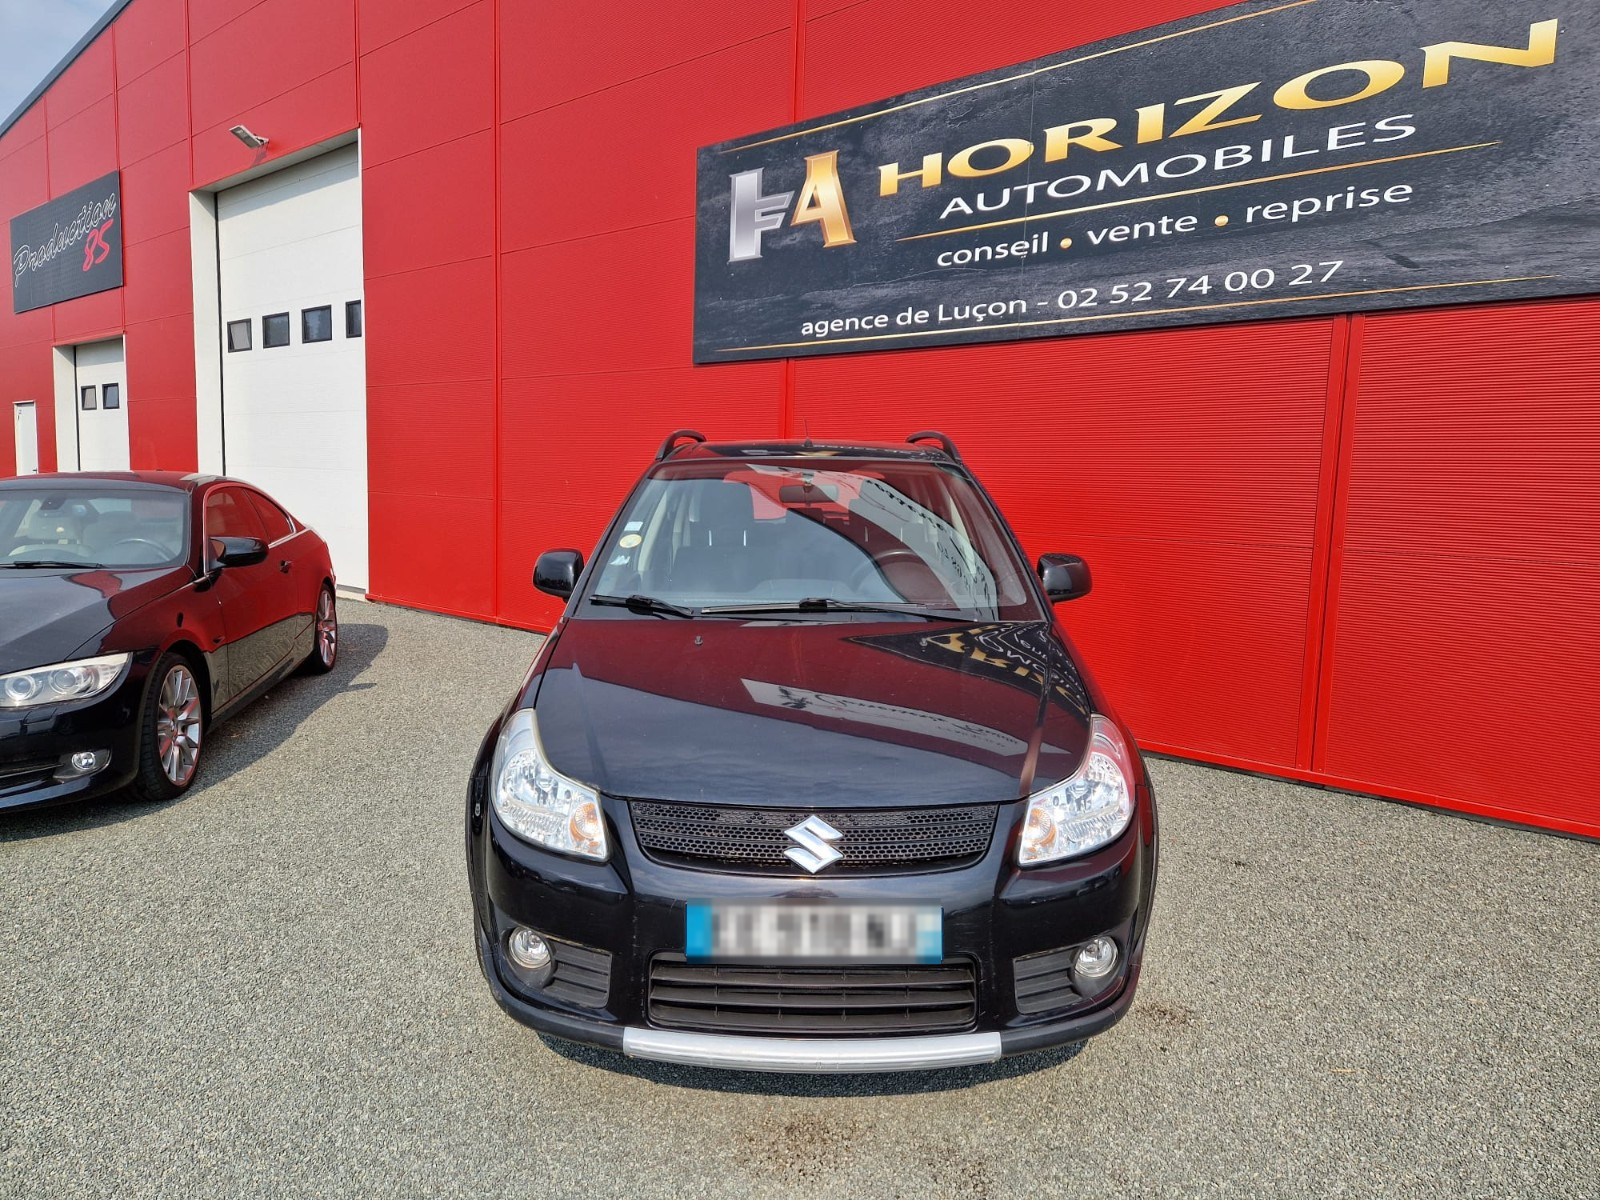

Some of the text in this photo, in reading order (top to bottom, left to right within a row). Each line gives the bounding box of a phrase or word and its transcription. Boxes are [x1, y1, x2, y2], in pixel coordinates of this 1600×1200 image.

[878, 19, 1558, 197] HORIZON
[939, 114, 1416, 219] AUTOMOBILES
[13, 192, 117, 288] Production 85
[937, 183, 1413, 267] conseil vente reprise
[801, 313, 889, 338] agence
[895, 306, 930, 326] de
[938, 298, 1027, 322] Luçon
[1057, 288, 1098, 309] 02
[1109, 282, 1152, 304] 52
[1166, 274, 1213, 299] 74
[1224, 268, 1275, 293] 00
[1289, 260, 1344, 287] 27
